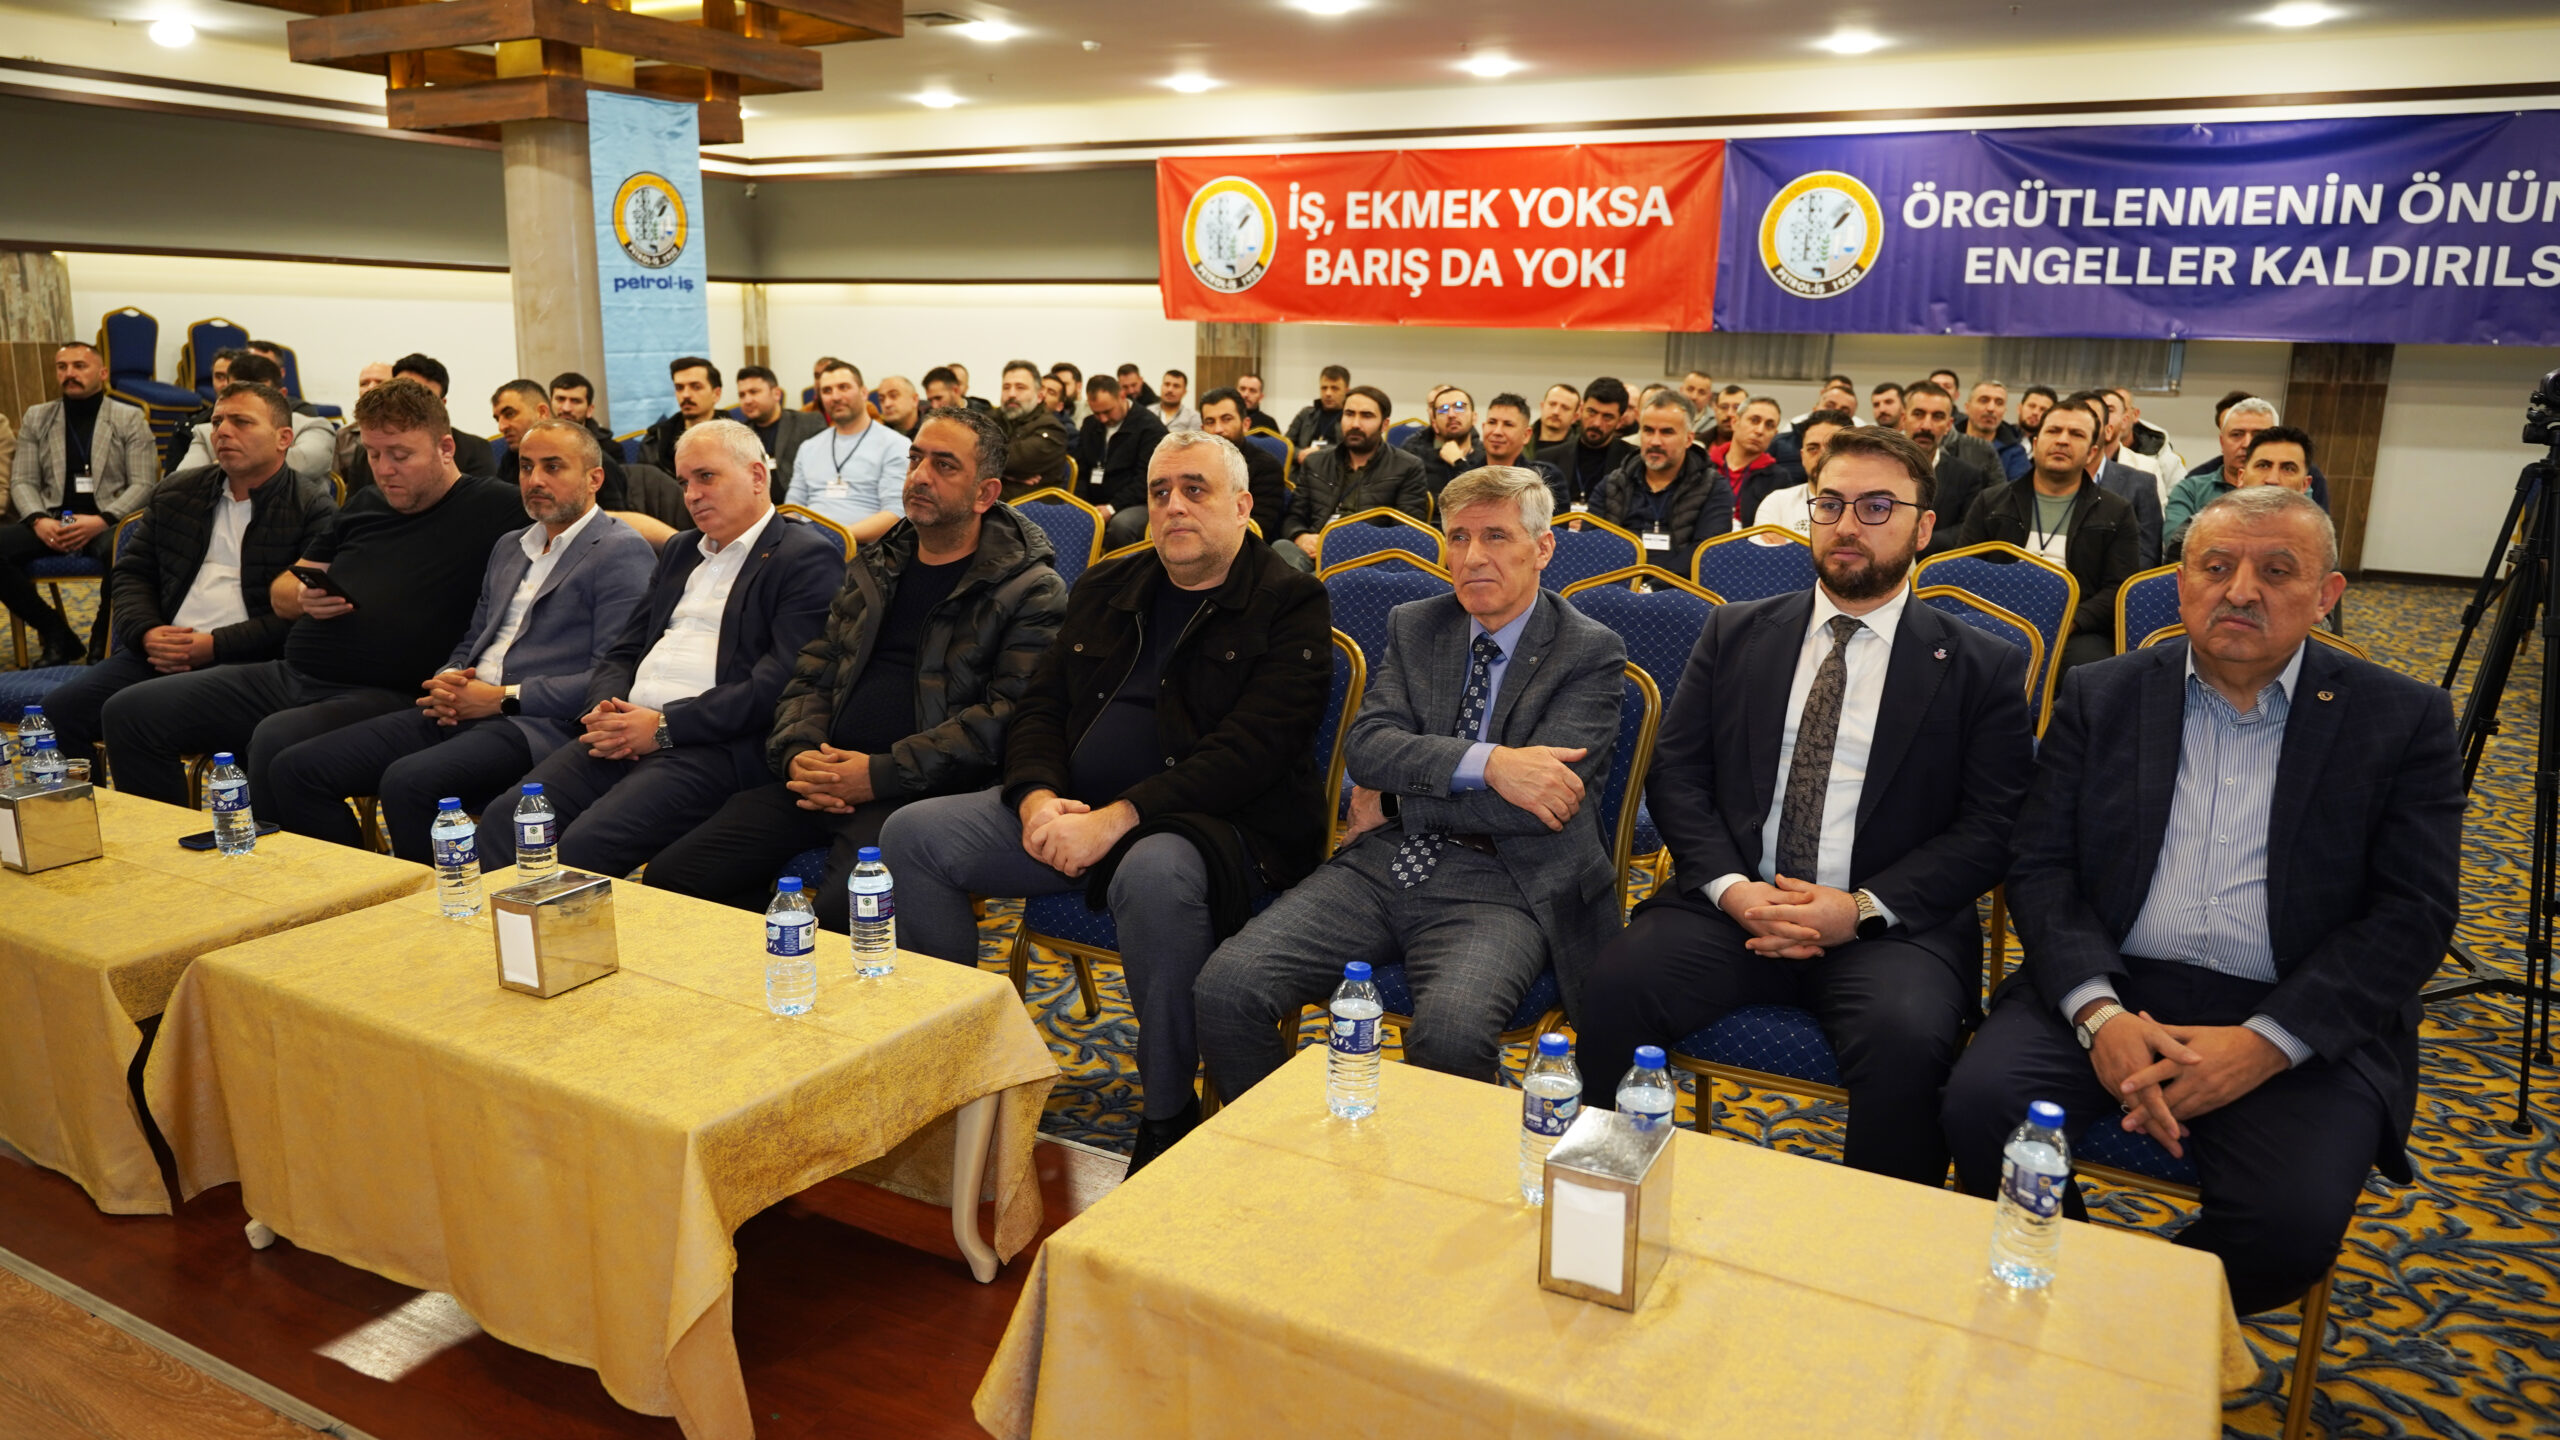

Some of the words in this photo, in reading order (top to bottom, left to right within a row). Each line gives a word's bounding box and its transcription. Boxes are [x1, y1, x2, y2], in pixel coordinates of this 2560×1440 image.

[1287, 182, 1336, 241] İŞ,
[1346, 188, 1502, 230] EKMEK
[1508, 185, 1674, 229] YOKSA
[1902, 173, 2385, 230] ÖRGÜTLENMENİN
[613, 274, 695, 294] petrol-iş
[1305, 247, 1430, 298] BARIŞ
[1440, 247, 1504, 288] DA
[1513, 247, 1626, 289] YOK!
[1964, 246, 2237, 286] ENGELLER
[2250, 245, 2560, 288] KALDIRILS
